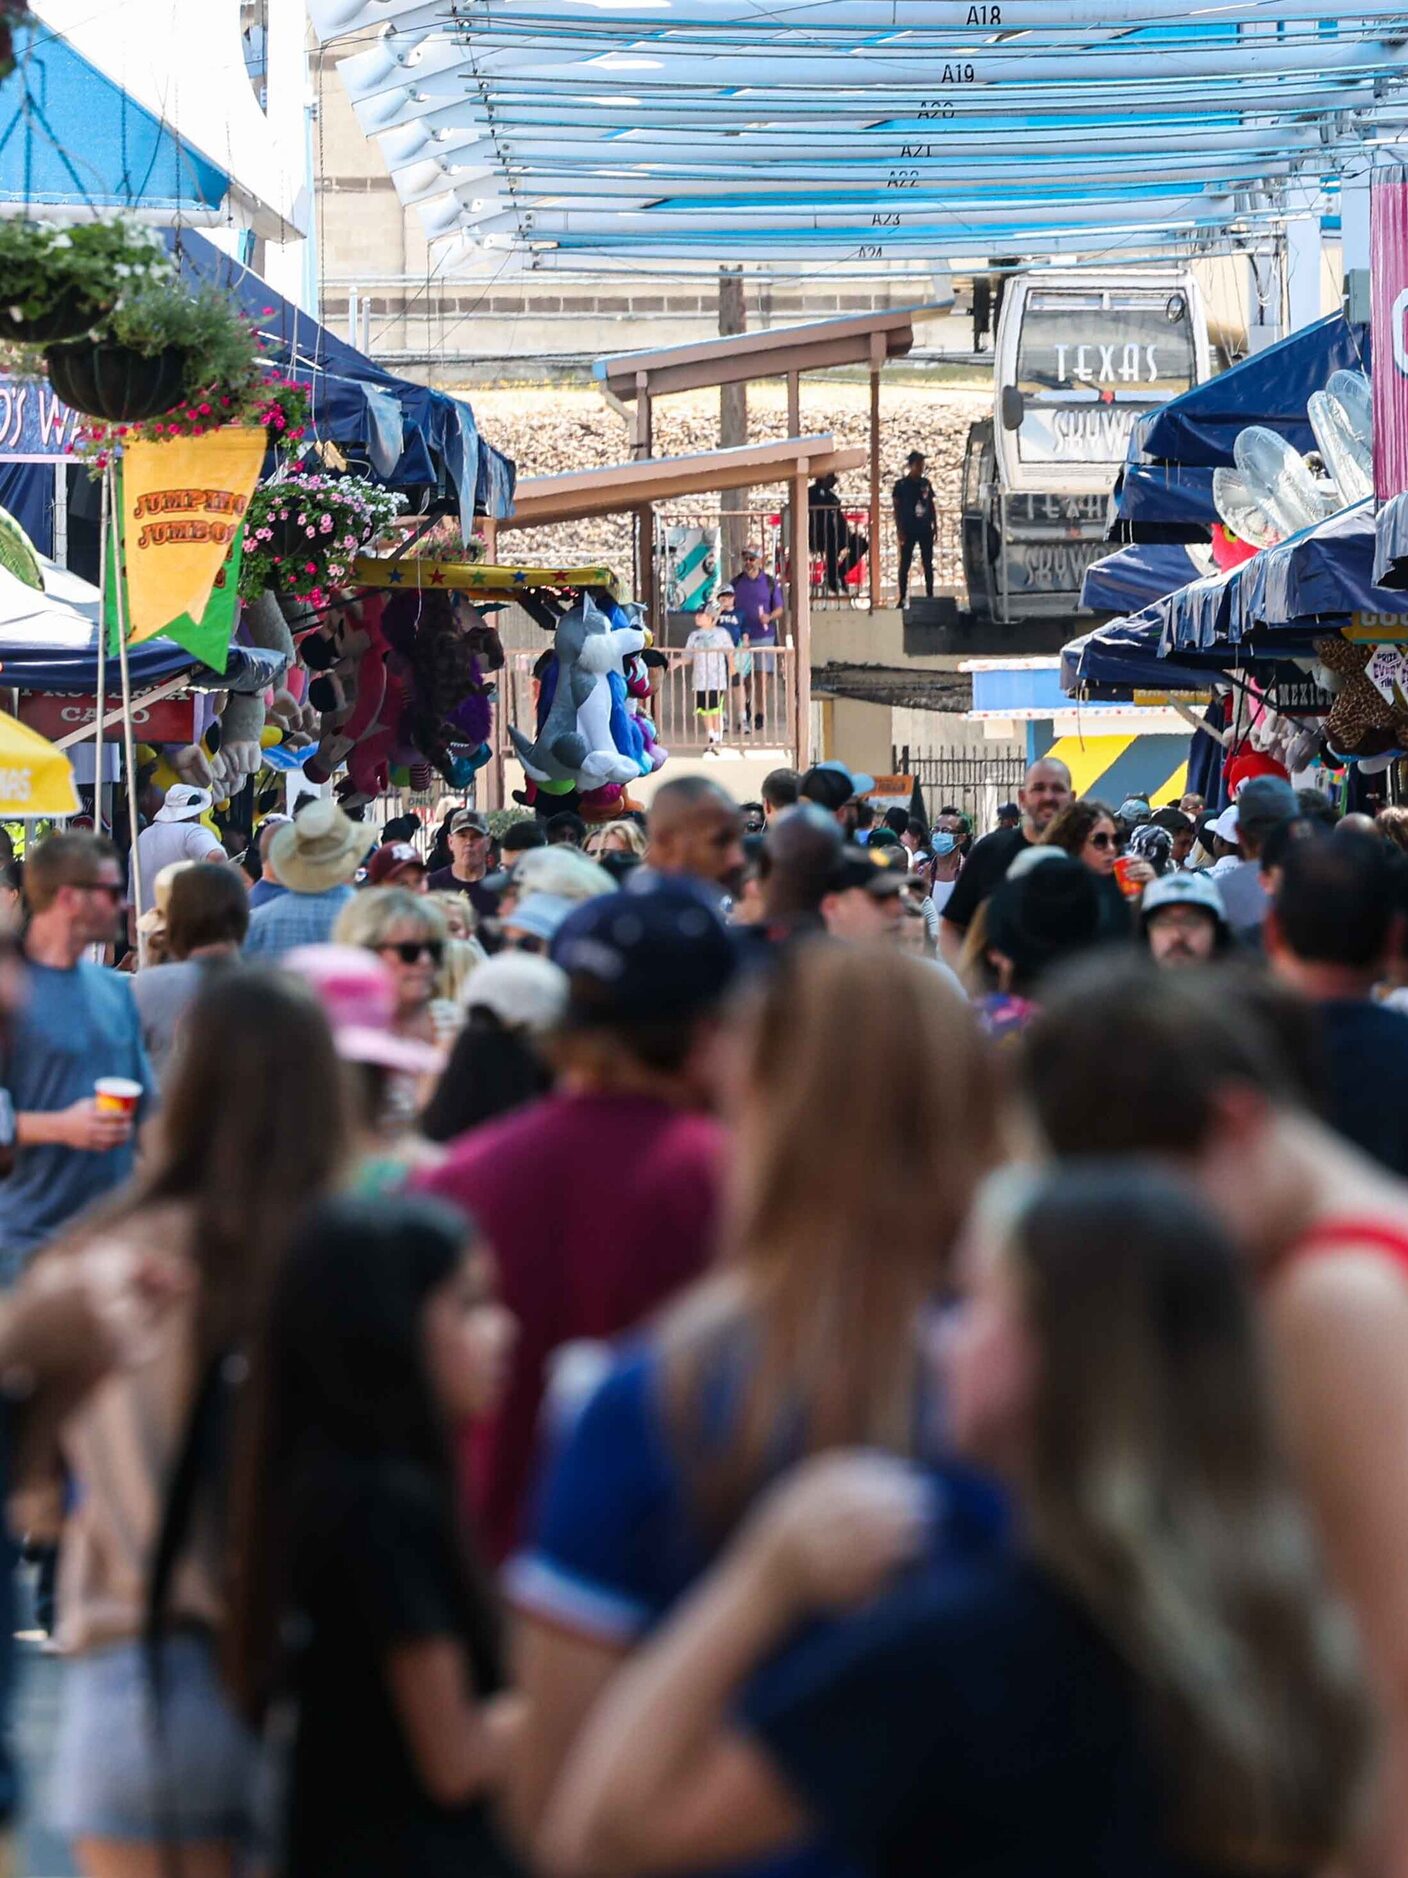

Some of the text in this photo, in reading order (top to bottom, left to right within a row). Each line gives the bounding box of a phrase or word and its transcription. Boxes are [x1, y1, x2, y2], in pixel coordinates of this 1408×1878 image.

[966, 5, 1001, 25] A18
[941, 63, 975, 83] A19
[887, 170, 920, 188] A22
[1054, 343, 1159, 382] TEXAS
[1053, 407, 1142, 452] SKYW
